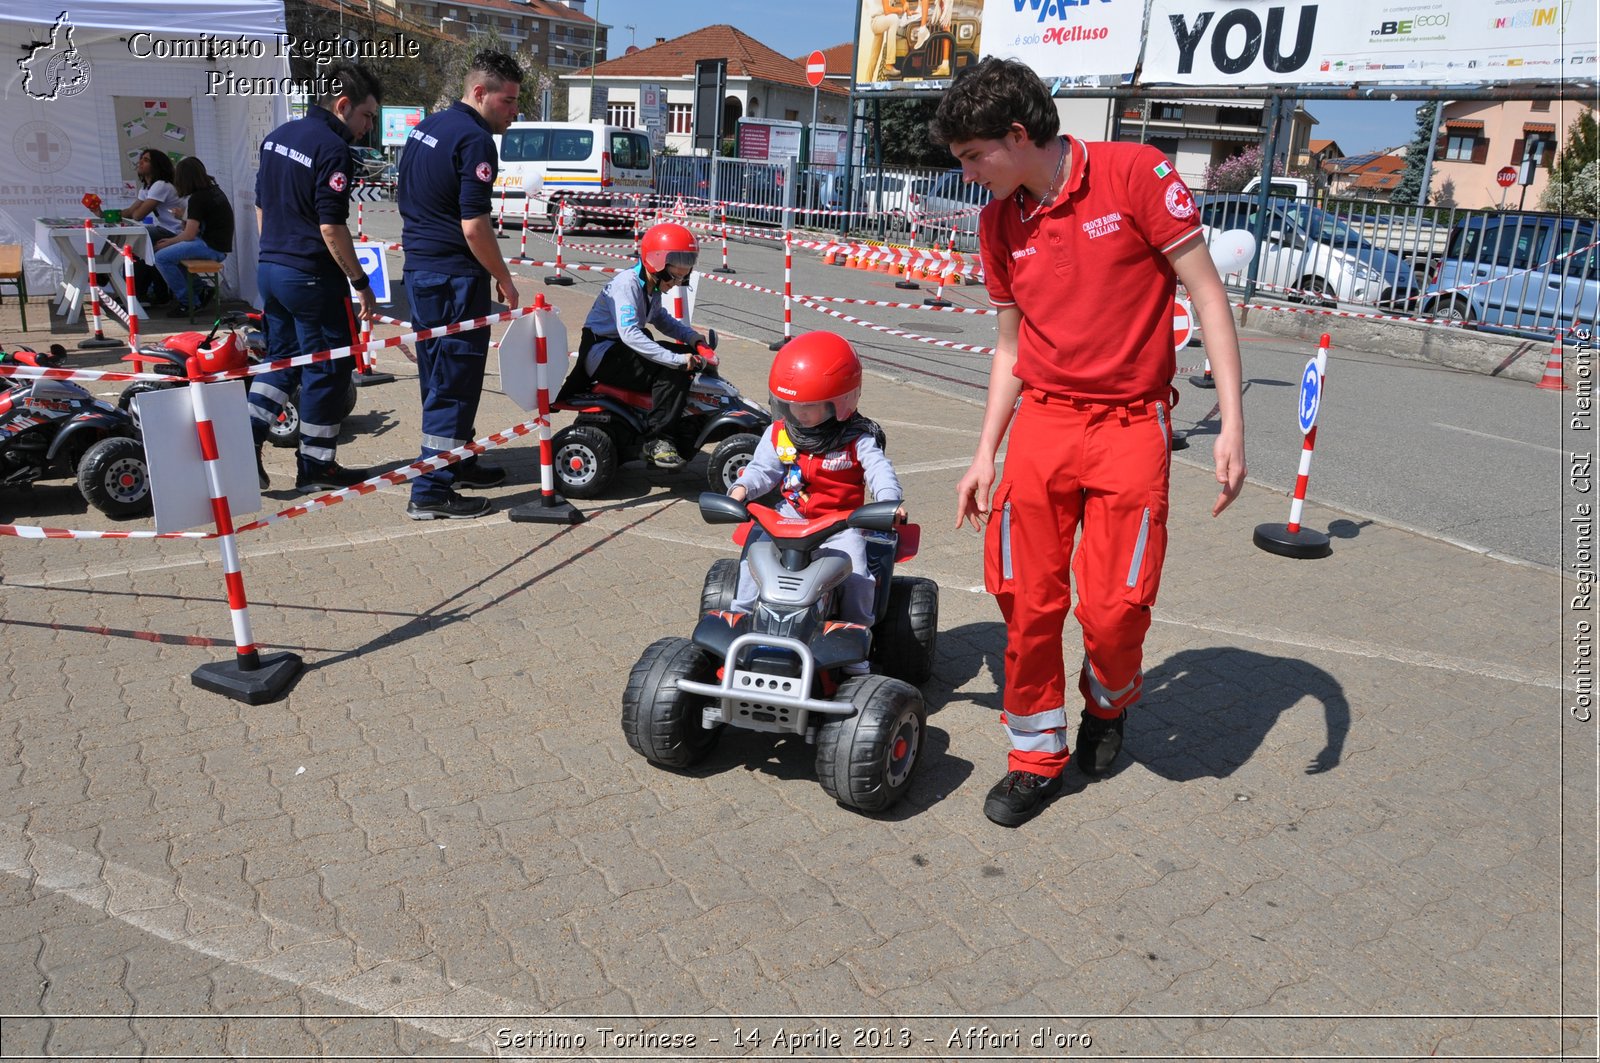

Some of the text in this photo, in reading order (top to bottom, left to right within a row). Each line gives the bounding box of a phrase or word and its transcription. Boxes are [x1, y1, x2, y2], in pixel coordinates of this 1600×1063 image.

[1022, 33, 1040, 45] solo
[1042, 25, 1109, 45] Melluso
[1168, 4, 1319, 75] YOU
[1497, 172, 1516, 182] STOP
[1083, 211, 1122, 232] CROCE ROSSA
[1088, 222, 1120, 239] ITALIANA
[777, 386, 797, 397] DUCATI
